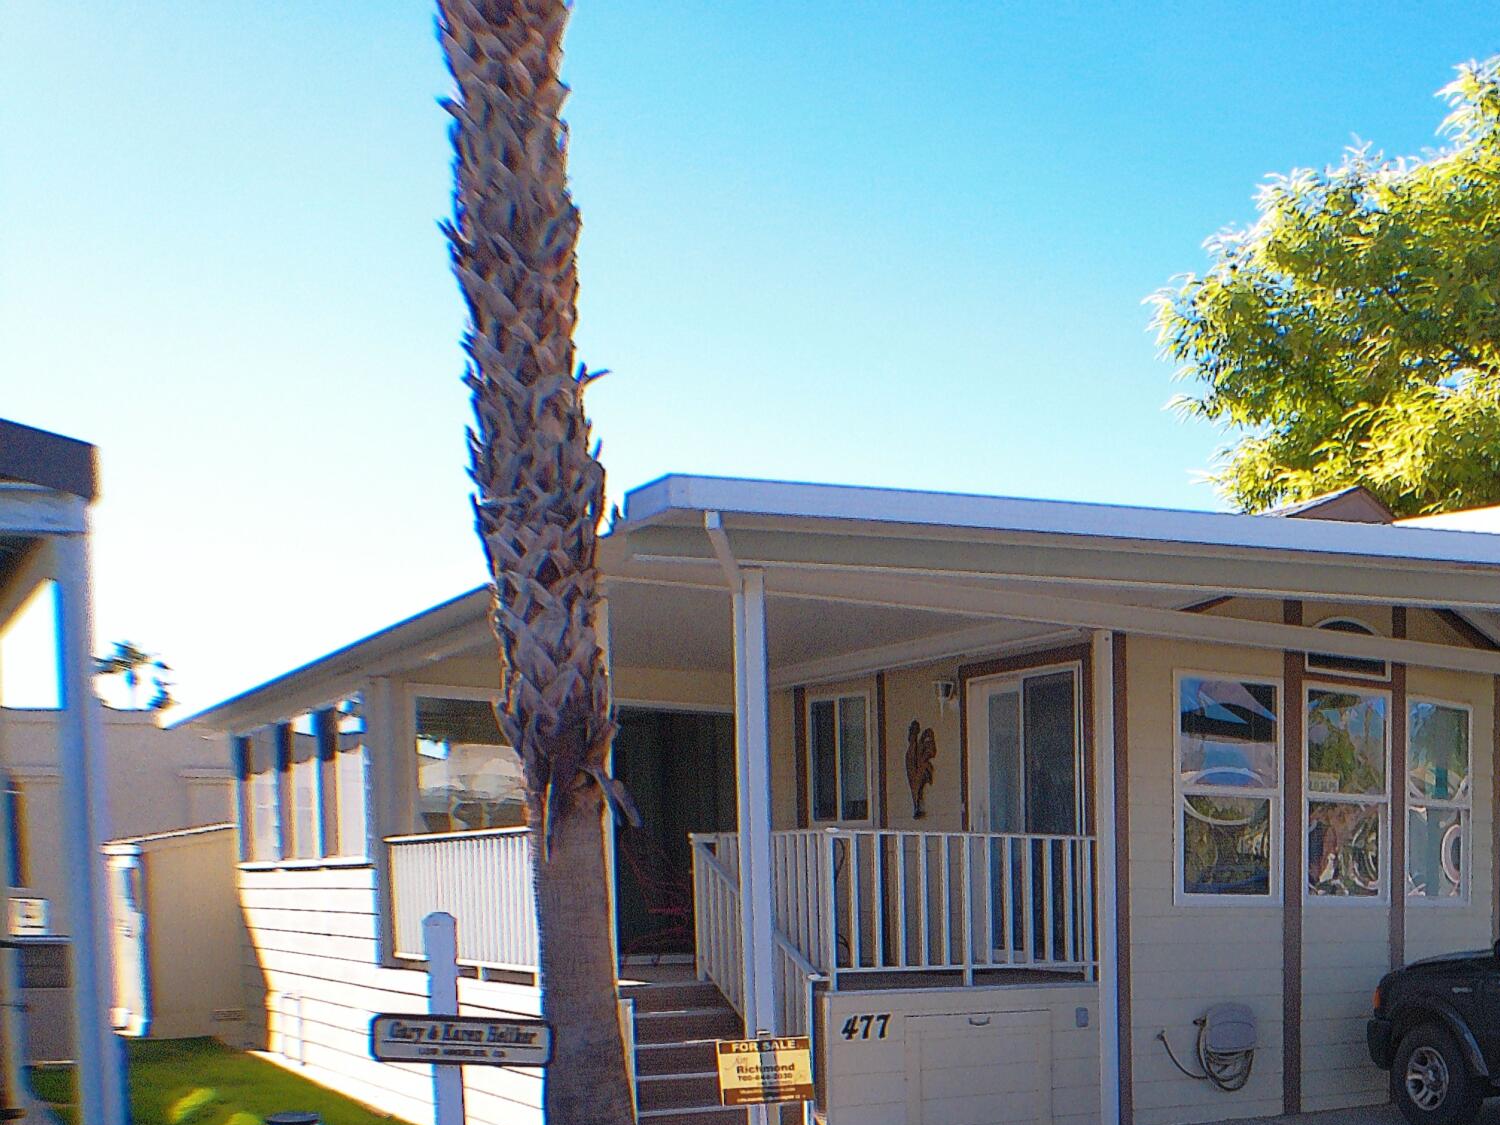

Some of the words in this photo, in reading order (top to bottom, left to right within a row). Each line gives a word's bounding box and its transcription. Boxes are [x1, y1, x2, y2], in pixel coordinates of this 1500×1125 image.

[841, 1013, 891, 1040] 477
[731, 1042, 759, 1052] FOR
[762, 1040, 796, 1051] SALE
[736, 1063, 795, 1074] Richmond
